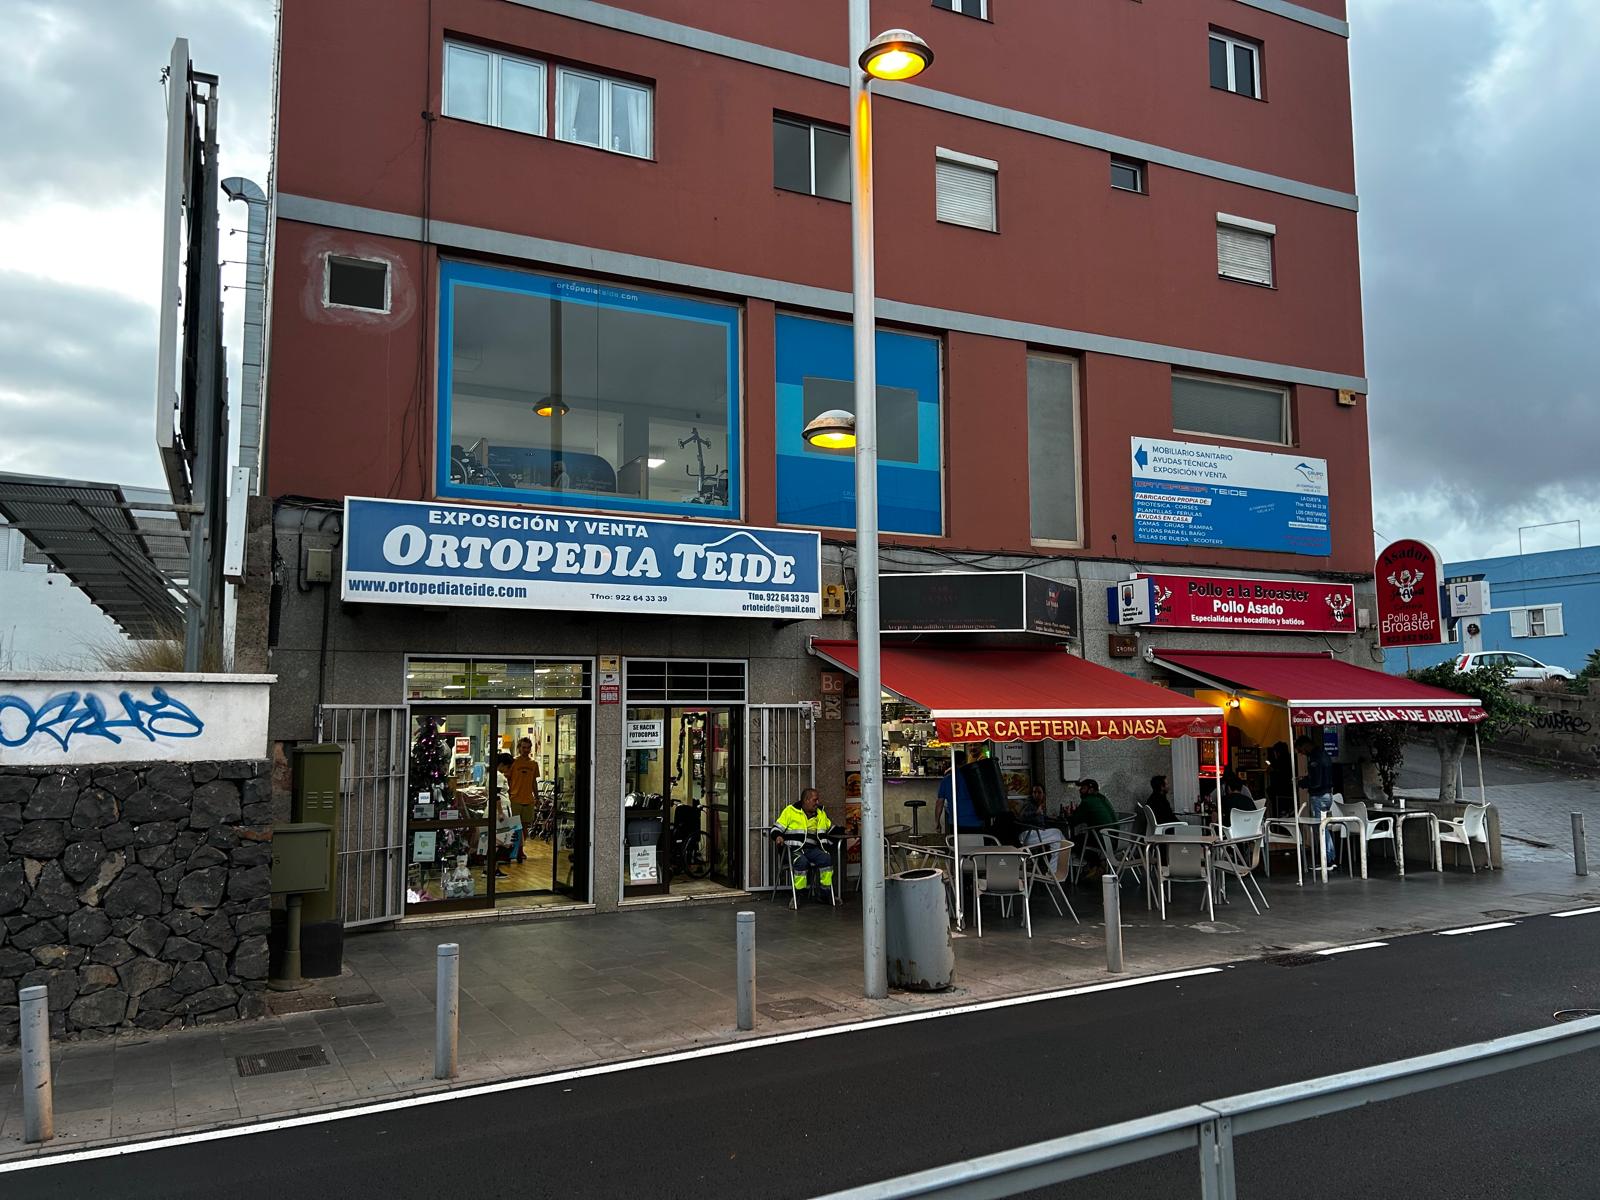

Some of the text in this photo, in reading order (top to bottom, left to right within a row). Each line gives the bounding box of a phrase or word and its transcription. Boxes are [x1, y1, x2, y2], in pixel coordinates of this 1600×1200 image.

[1152, 446, 1233, 461] MOBILIARIO SANITARIO
[1152, 456, 1182, 465] AYUDAS
[1153, 466, 1197, 477] EXPOSICIÓN
[1204, 471, 1228, 479] VENTA
[1136, 493, 1176, 502] FABRICACIÓN
[428, 510, 649, 538] EXPOSICIÓN Y VENTA
[382, 524, 796, 585] ORTOPEDIA TEIDE
[1384, 545, 1429, 565] Asador
[348, 579, 527, 598] www.ortopediateide.com
[1188, 581, 1309, 602] Pollo a la Broaster
[590, 593, 613, 601] Tfno:
[766, 593, 780, 602] 922
[780, 593, 790, 602] 64
[790, 594, 800, 603] 33
[800, 594, 810, 603] 39
[741, 603, 816, 614] ortoteide@gmail.com
[1213, 600, 1284, 615] Pollo Asado
[1191, 614, 1233, 623] Especialidad
[1243, 616, 1276, 624] bocadillos
[1281, 617, 1305, 626] batidos
[1387, 613, 1410, 623] Pollo
[1420, 611, 1429, 620] la
[1382, 618, 1435, 634] Broaster
[822, 674, 842, 691] Bc
[1313, 706, 1468, 725] CAFETERÍA 3 DE ABRIL
[951, 719, 1167, 739] BAR CAFETERIA LA NASA
